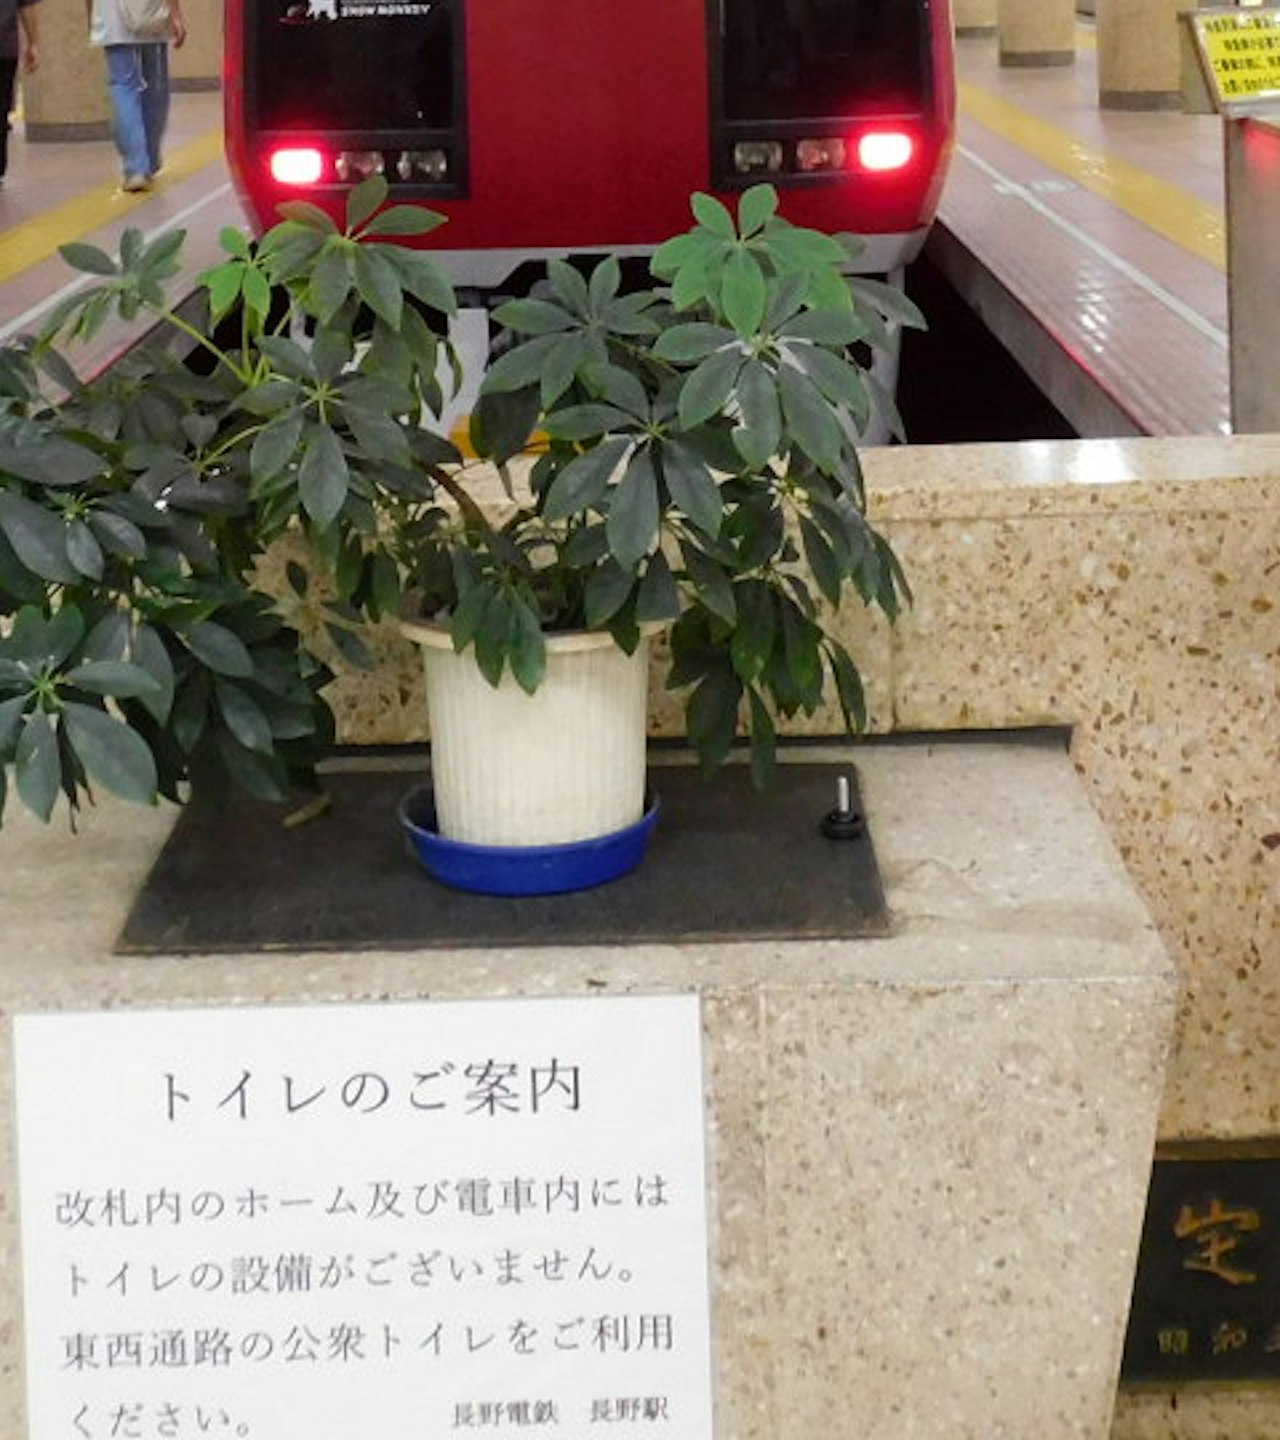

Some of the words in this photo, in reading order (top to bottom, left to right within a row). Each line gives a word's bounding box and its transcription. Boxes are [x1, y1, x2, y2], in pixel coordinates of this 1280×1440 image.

[162, 1056, 582, 1122] トイレのご案内
[55, 1174, 669, 1228] 改札内のホーム及び電車内には
[67, 1246, 635, 1298] トイレの設備がございません。
[60, 1313, 675, 1371] 東西通路の公衆トイレをご利用
[73, 1402, 249, 1438] ください。
[451, 1396, 560, 1427] 長野電鉄
[589, 1395, 669, 1424] 長野駅
